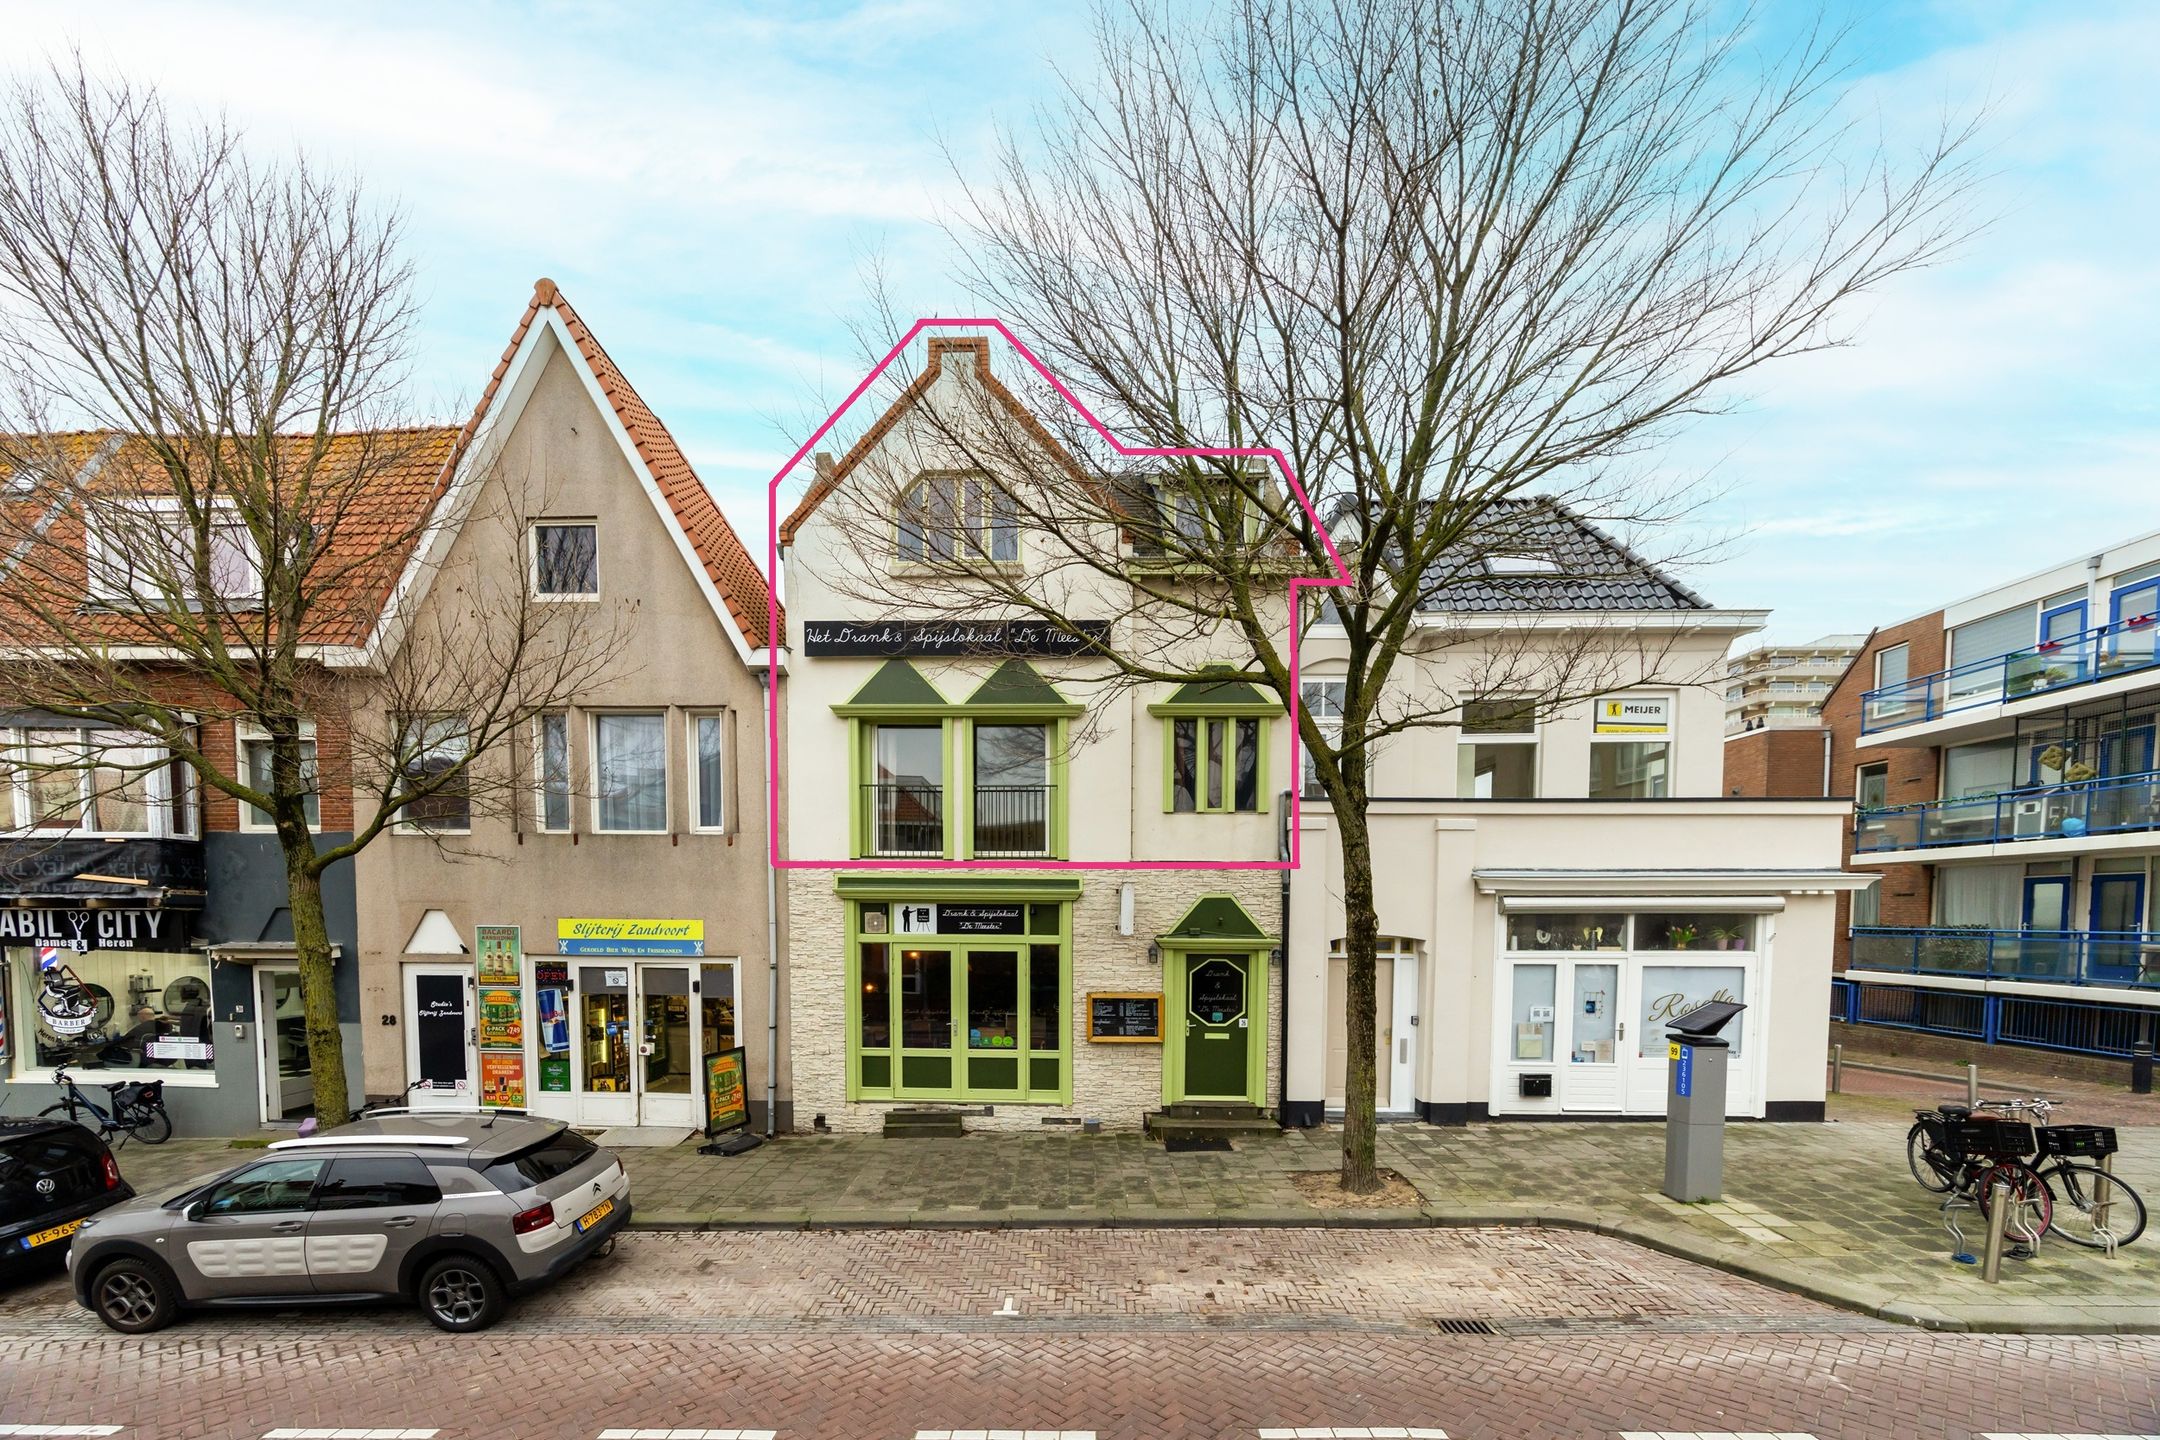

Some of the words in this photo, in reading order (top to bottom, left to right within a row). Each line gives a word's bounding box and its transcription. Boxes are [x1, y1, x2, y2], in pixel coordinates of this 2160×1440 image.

[806, 628, 832, 643] Het
[834, 628, 893, 643] Drank
[894, 632, 903, 643] &
[911, 627, 1003, 649] Spijslokaal
[1624, 705, 1661, 714] MEIJER
[943, 909, 968, 917] Drank
[97, 910, 162, 939] CITY
[573, 923, 625, 938] Slijterij
[628, 923, 690, 936] Zandvoort
[35, 938, 73, 948] Dames
[76, 940, 85, 951] &
[98, 938, 134, 948] Heren
[536, 970, 567, 980] OPEN
[52, 1018, 86, 1026] BARBER
[381, 1014, 397, 1026] 28
[1671, 1046, 1678, 1056] 99
[582, 1202, 612, 1227] H-783-TN
